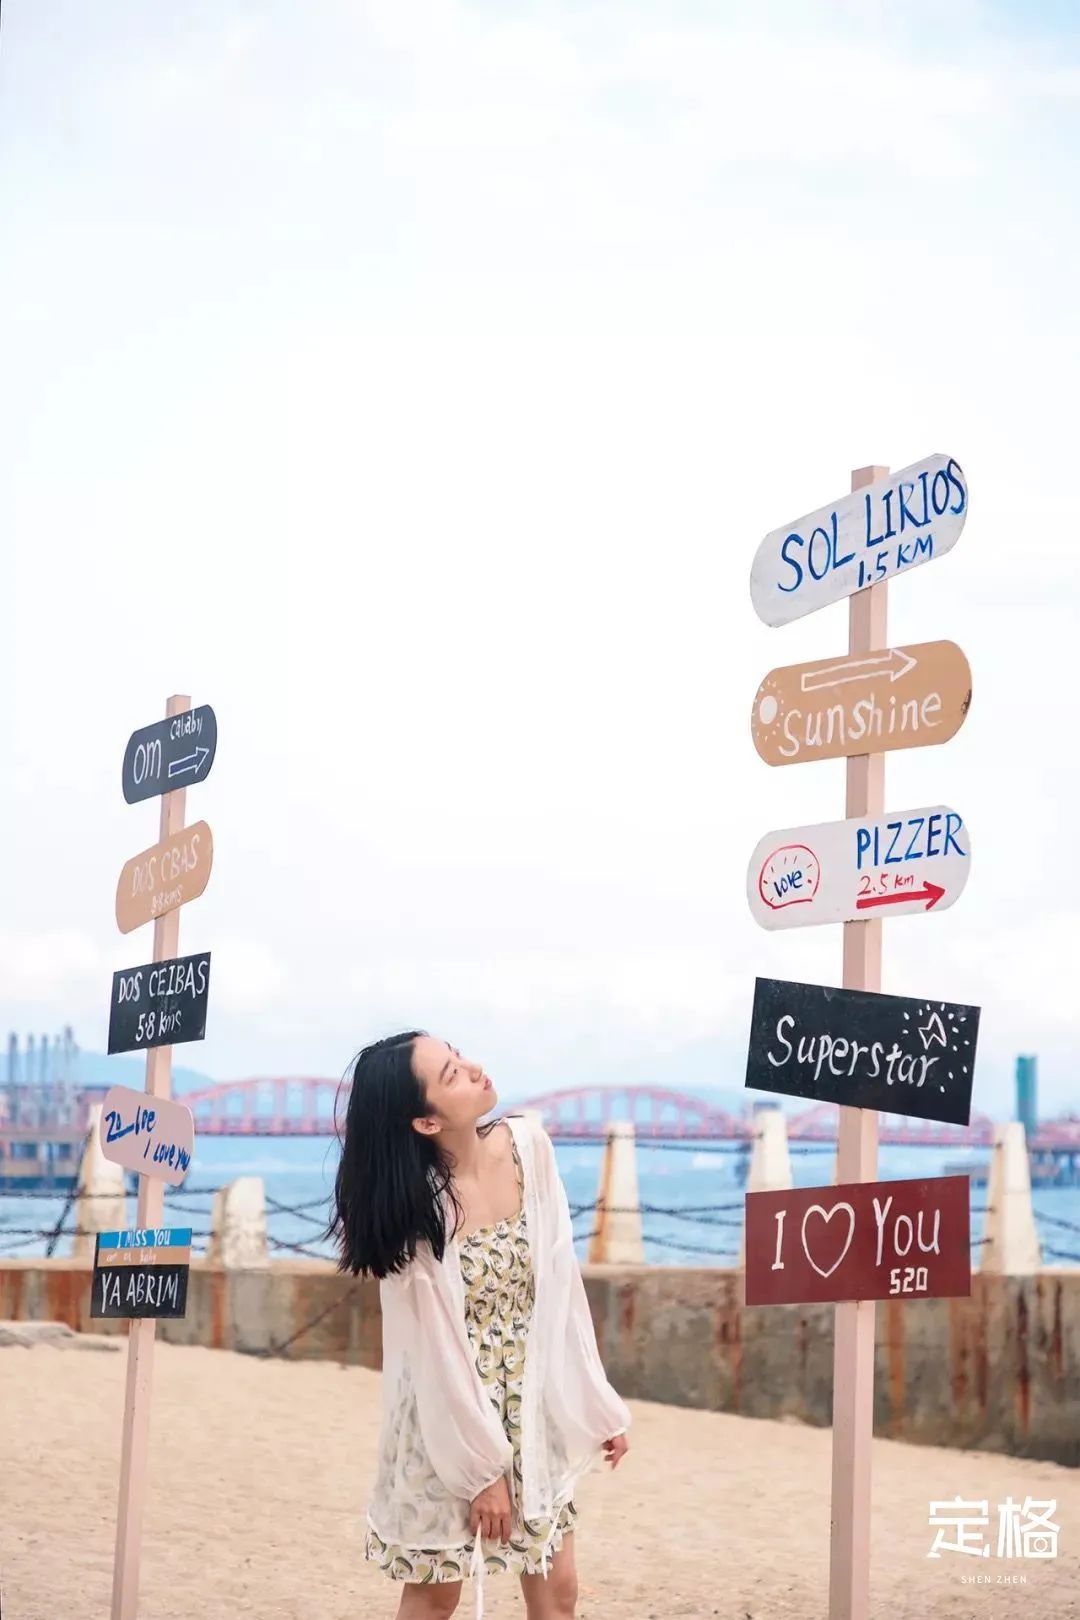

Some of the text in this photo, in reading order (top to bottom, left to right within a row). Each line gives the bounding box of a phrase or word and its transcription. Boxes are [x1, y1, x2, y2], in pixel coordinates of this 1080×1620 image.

[778, 458, 967, 593] SOL LIRIOS
[858, 533, 935, 588] 1.5 KM
[856, 812, 967, 870] PIZZER
[857, 873, 889, 896] 2.5
[118, 961, 208, 1004] DOS CEIBAS
[767, 1015, 940, 1087] Superstar
[124, 1229, 148, 1248] MISS
[771, 1209, 788, 1270] I
[101, 1272, 178, 1314] YA ABRIM
[889, 1267, 929, 1294] 520
